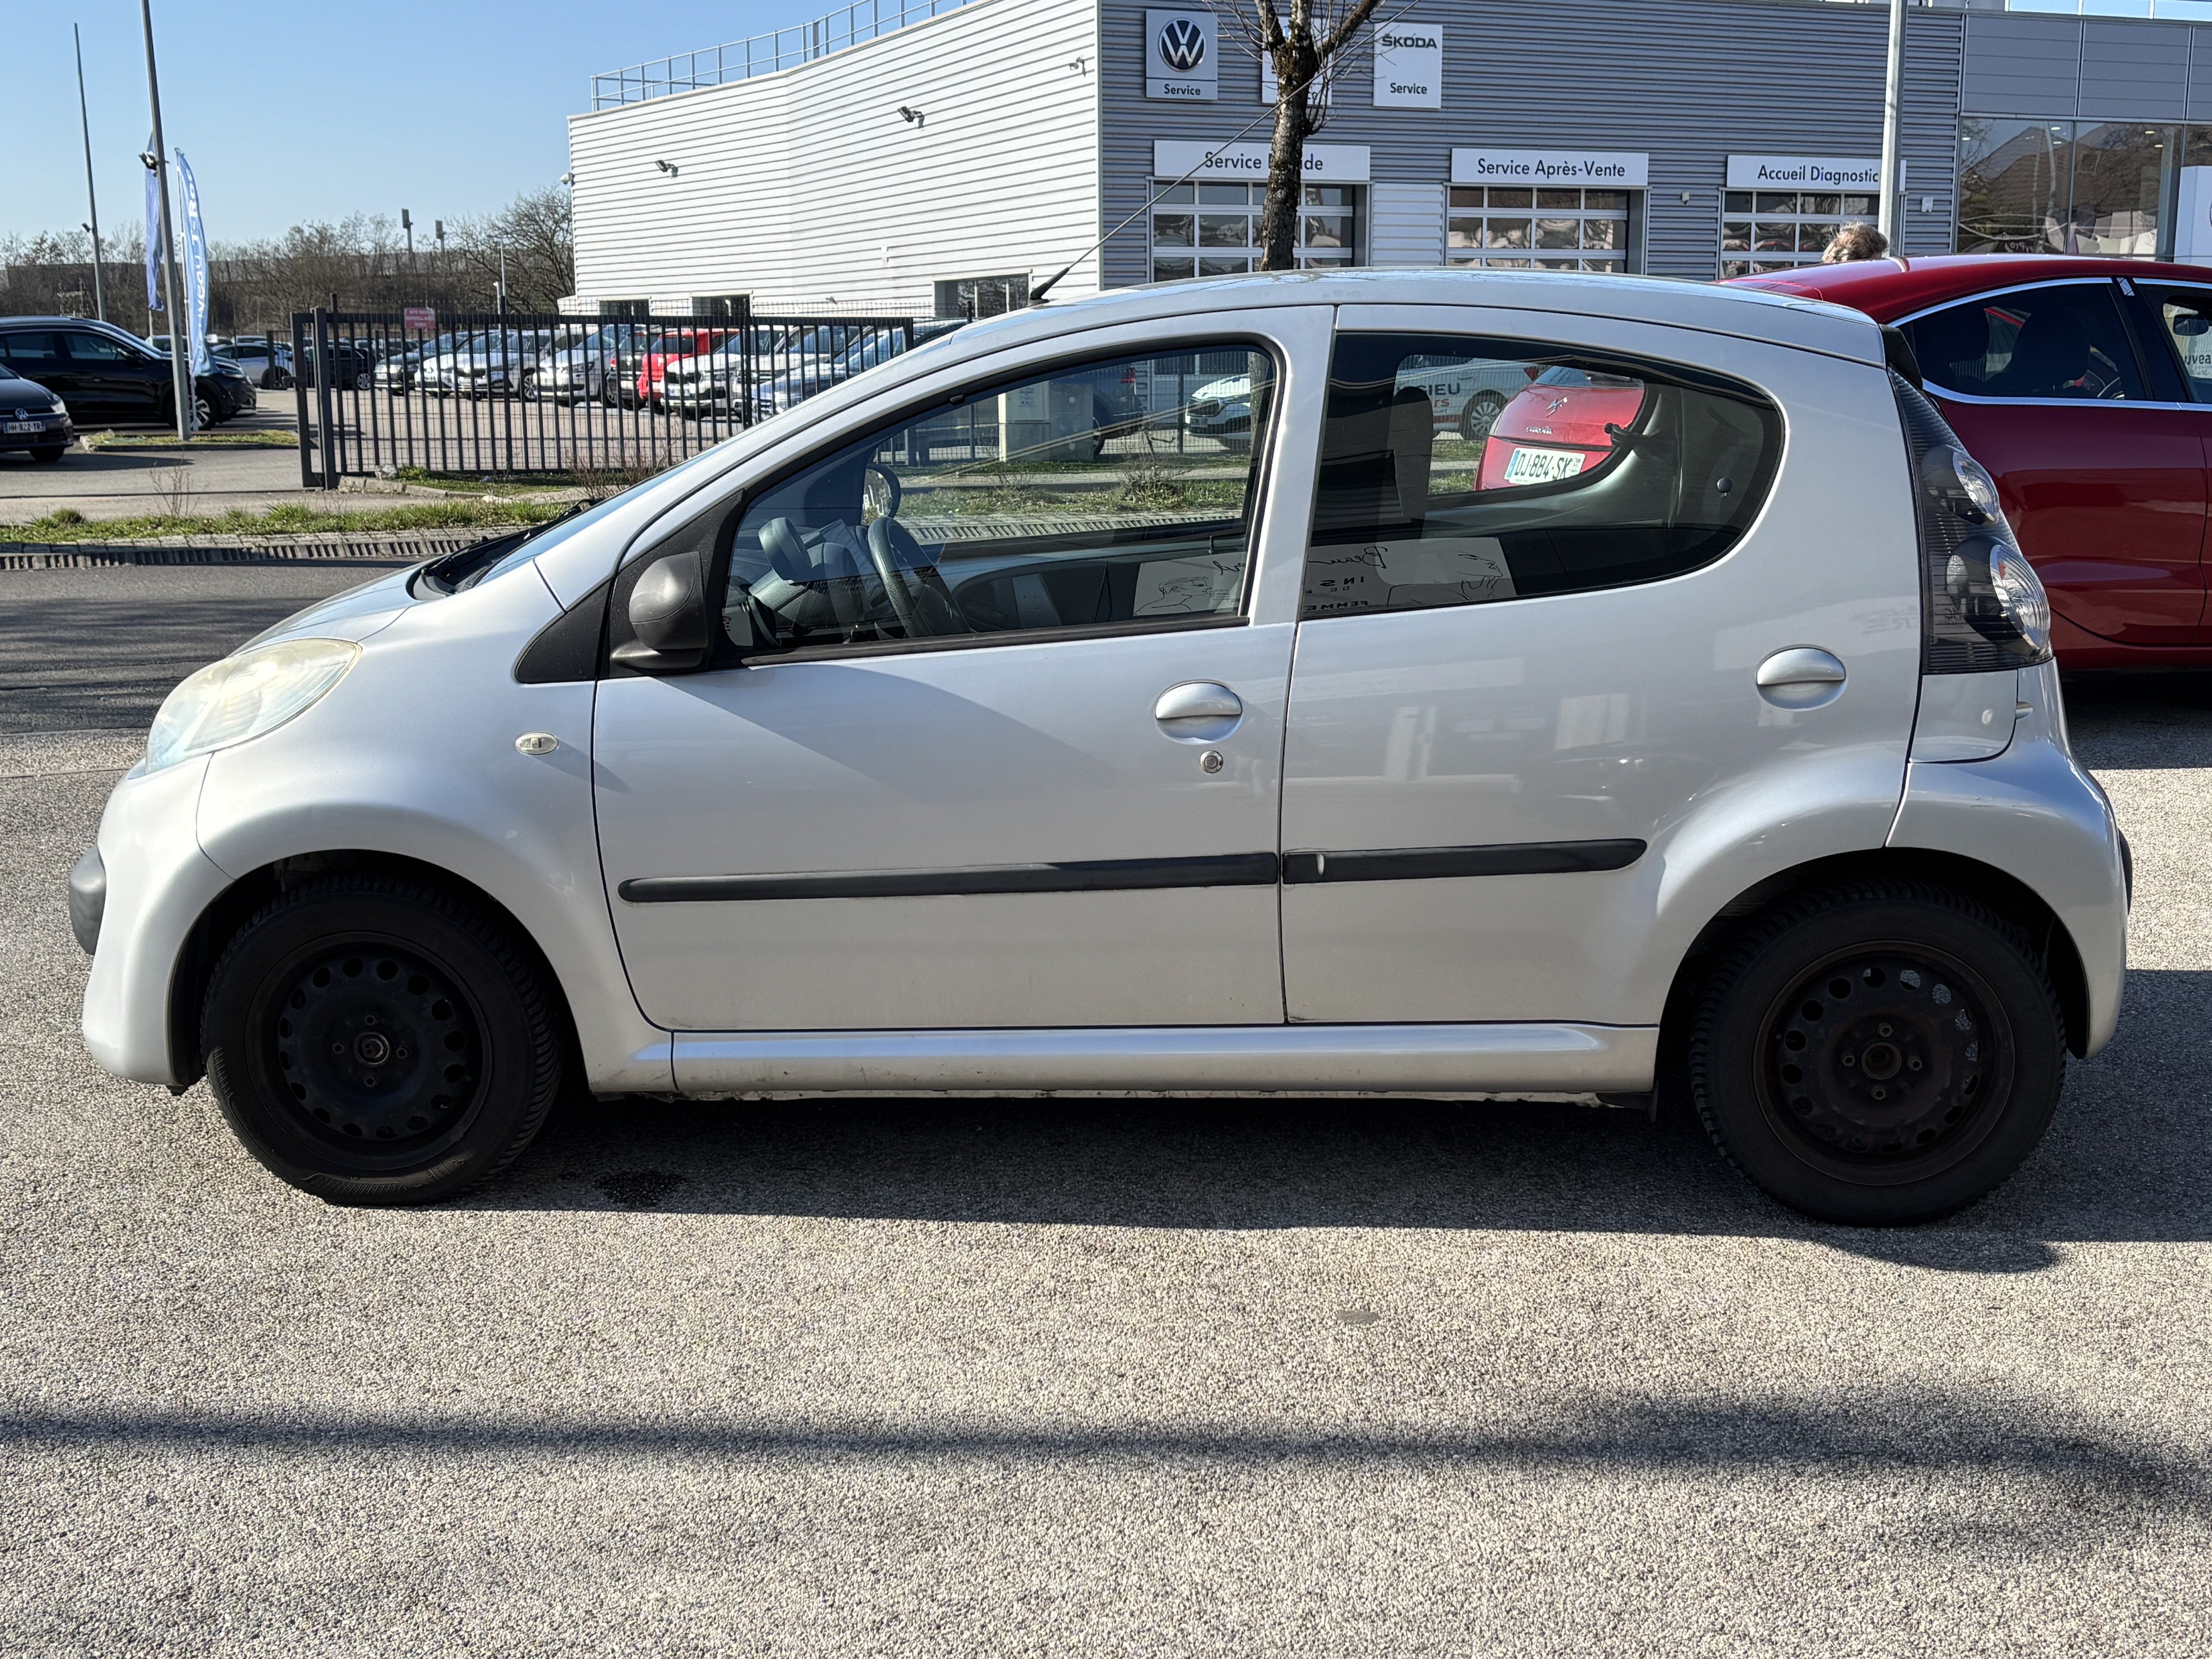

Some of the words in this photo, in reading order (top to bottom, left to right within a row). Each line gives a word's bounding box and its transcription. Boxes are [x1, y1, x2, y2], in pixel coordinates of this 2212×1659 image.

[1164, 84, 1201, 95] Service
[1390, 82, 1427, 94] Service
[1204, 152, 1262, 169] Service
[1477, 158, 1530, 175] Service
[1535, 160, 1625, 179] Après-Vente
[1757, 165, 1805, 180] Accueil
[1810, 166, 1879, 185] Diagnostic
